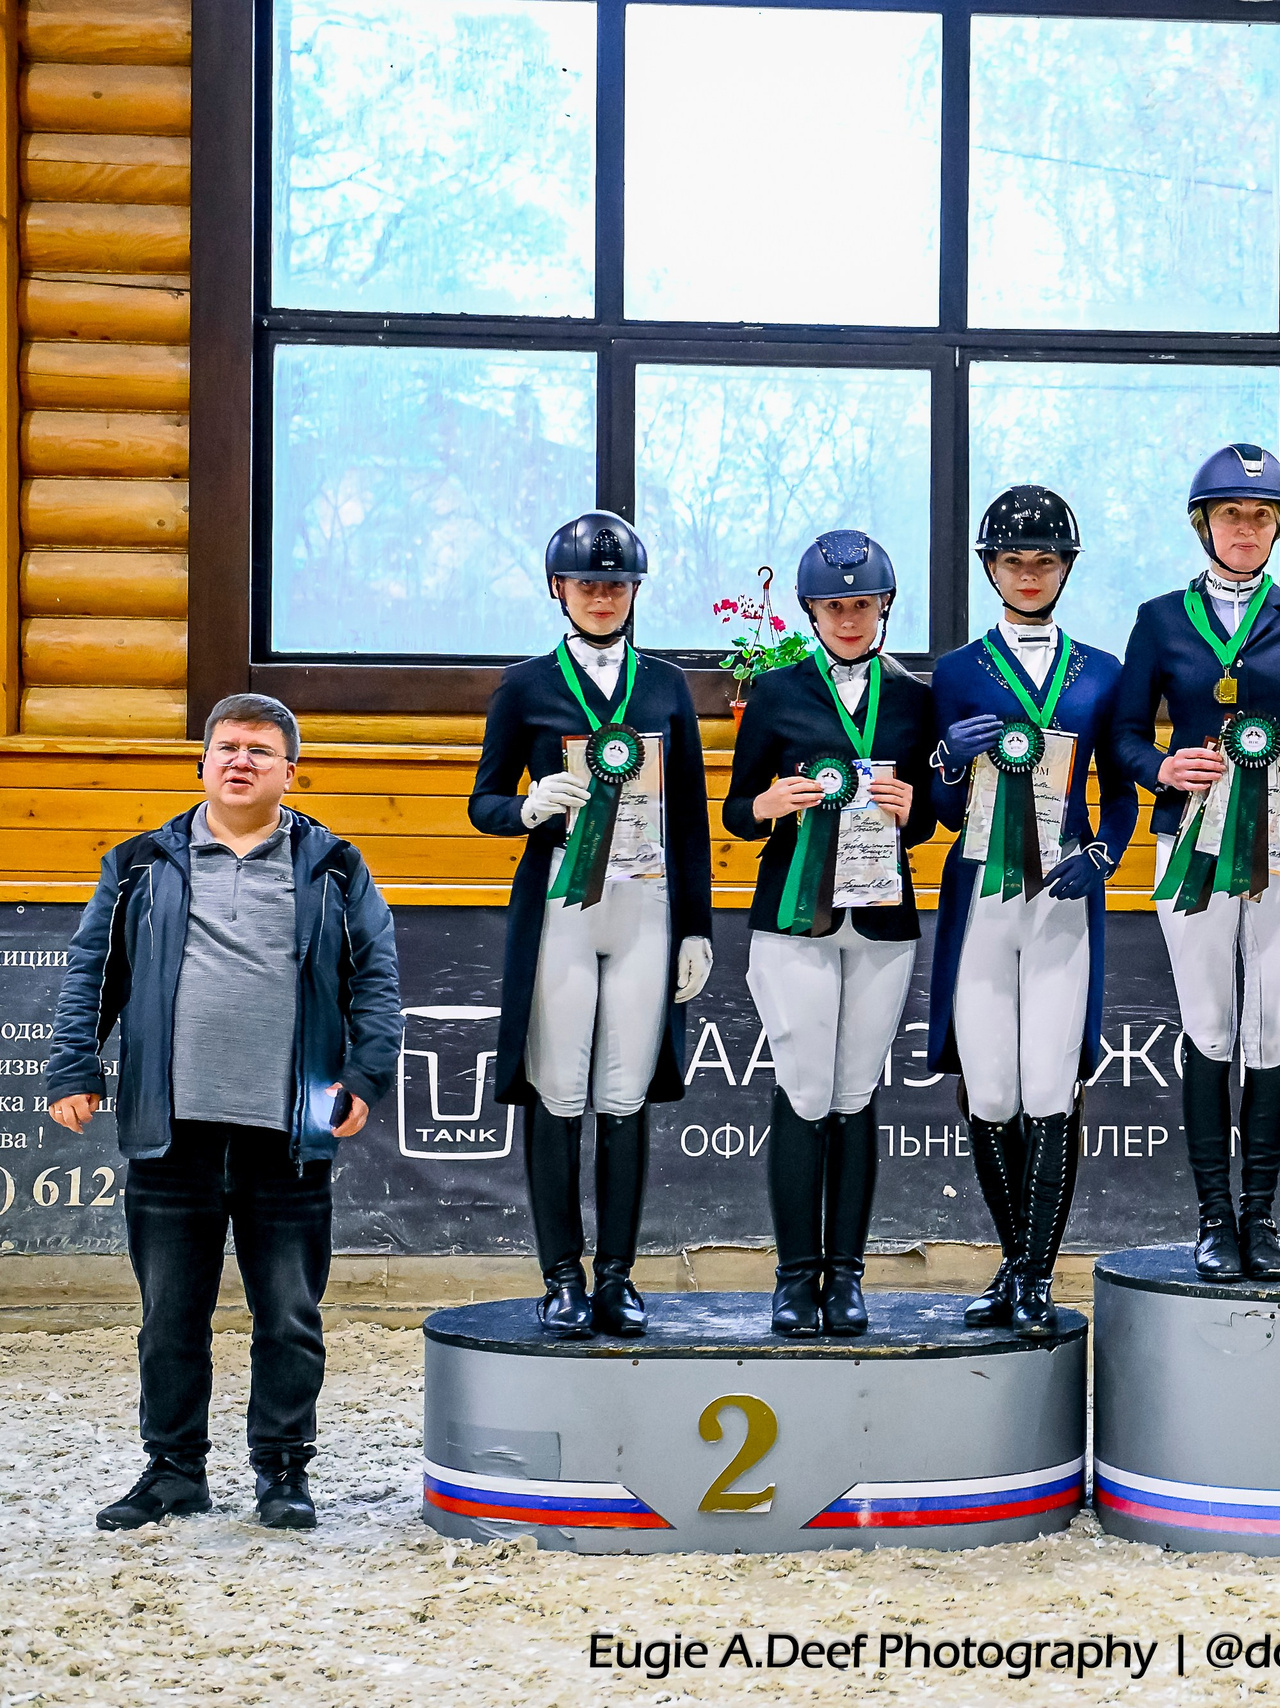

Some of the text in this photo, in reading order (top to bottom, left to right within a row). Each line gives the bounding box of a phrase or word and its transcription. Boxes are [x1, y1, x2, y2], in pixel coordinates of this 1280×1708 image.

[0, 950, 69, 970] иции
[415, 1128, 497, 1143] TANK
[698, 1393, 779, 1514] 2
